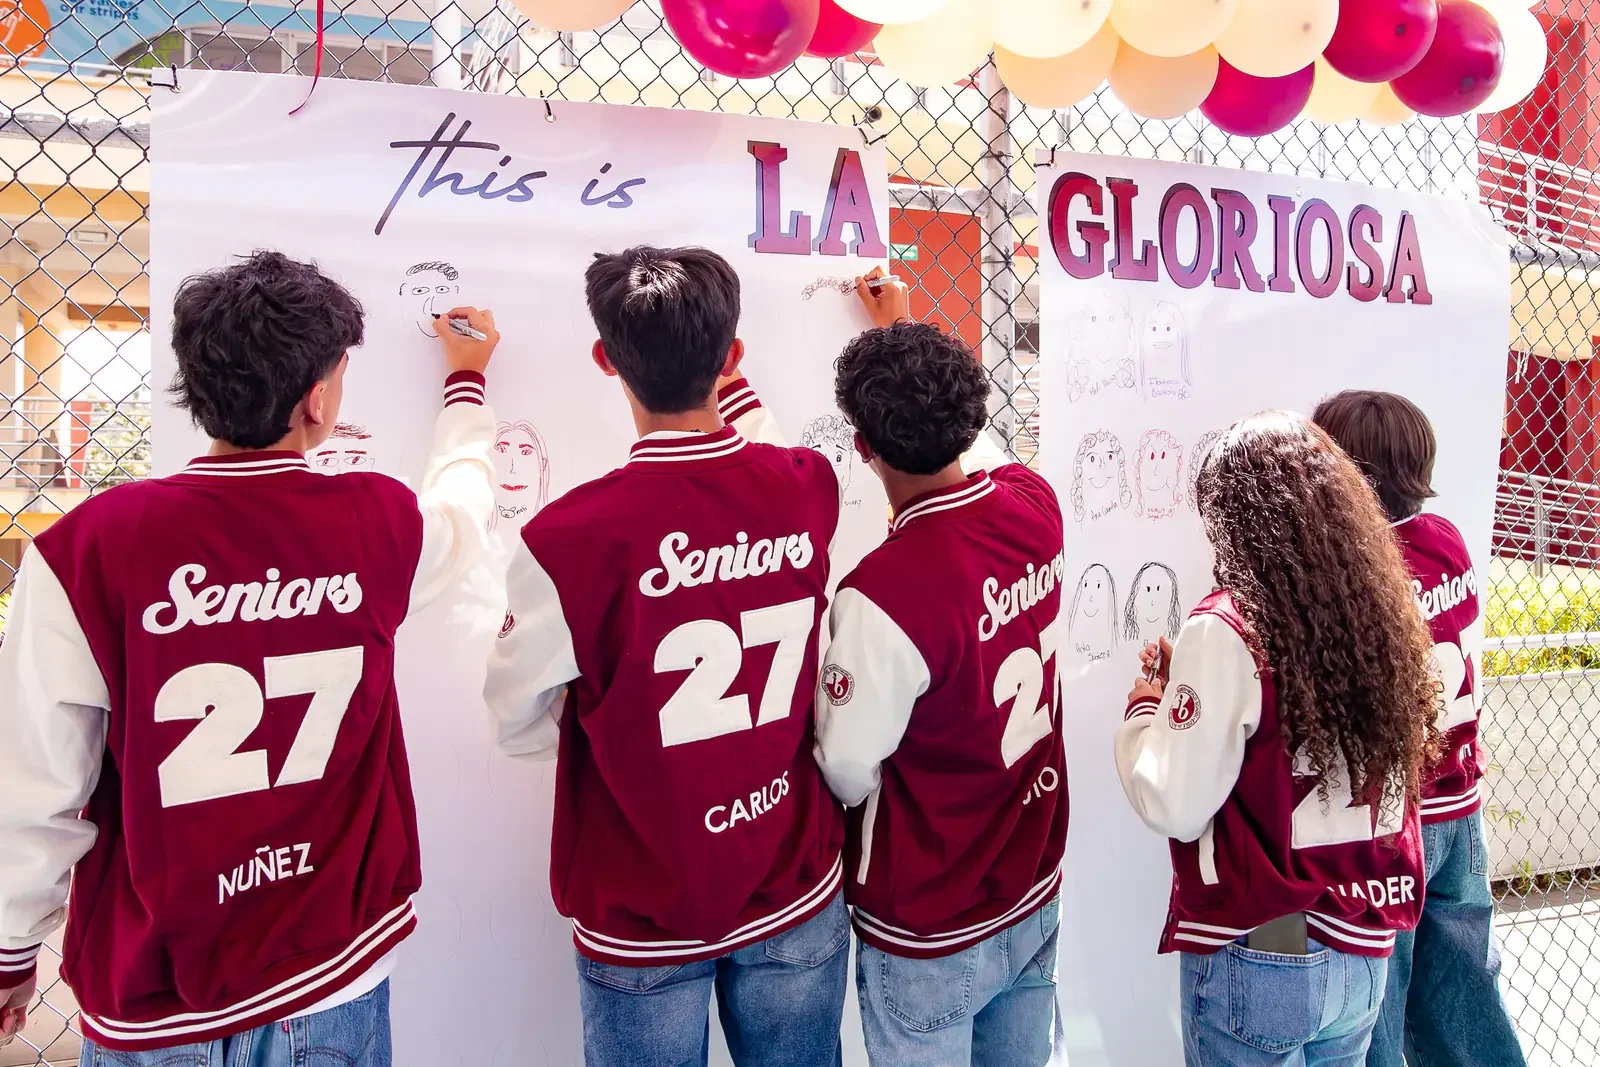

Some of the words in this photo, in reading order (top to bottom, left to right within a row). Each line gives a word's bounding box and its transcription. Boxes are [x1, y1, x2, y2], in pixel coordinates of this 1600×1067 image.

[375, 112, 547, 235] this
[581, 163, 646, 208] is
[747, 140, 887, 257] LA
[1047, 171, 1433, 305] GLORIOSA
[142, 563, 363, 635] Seniors
[638, 531, 814, 597] Seniors
[654, 596, 815, 748] 27
[154, 645, 364, 808] 27
[704, 770, 789, 833] CARLOS
[218, 842, 314, 904] NUÑEZ
